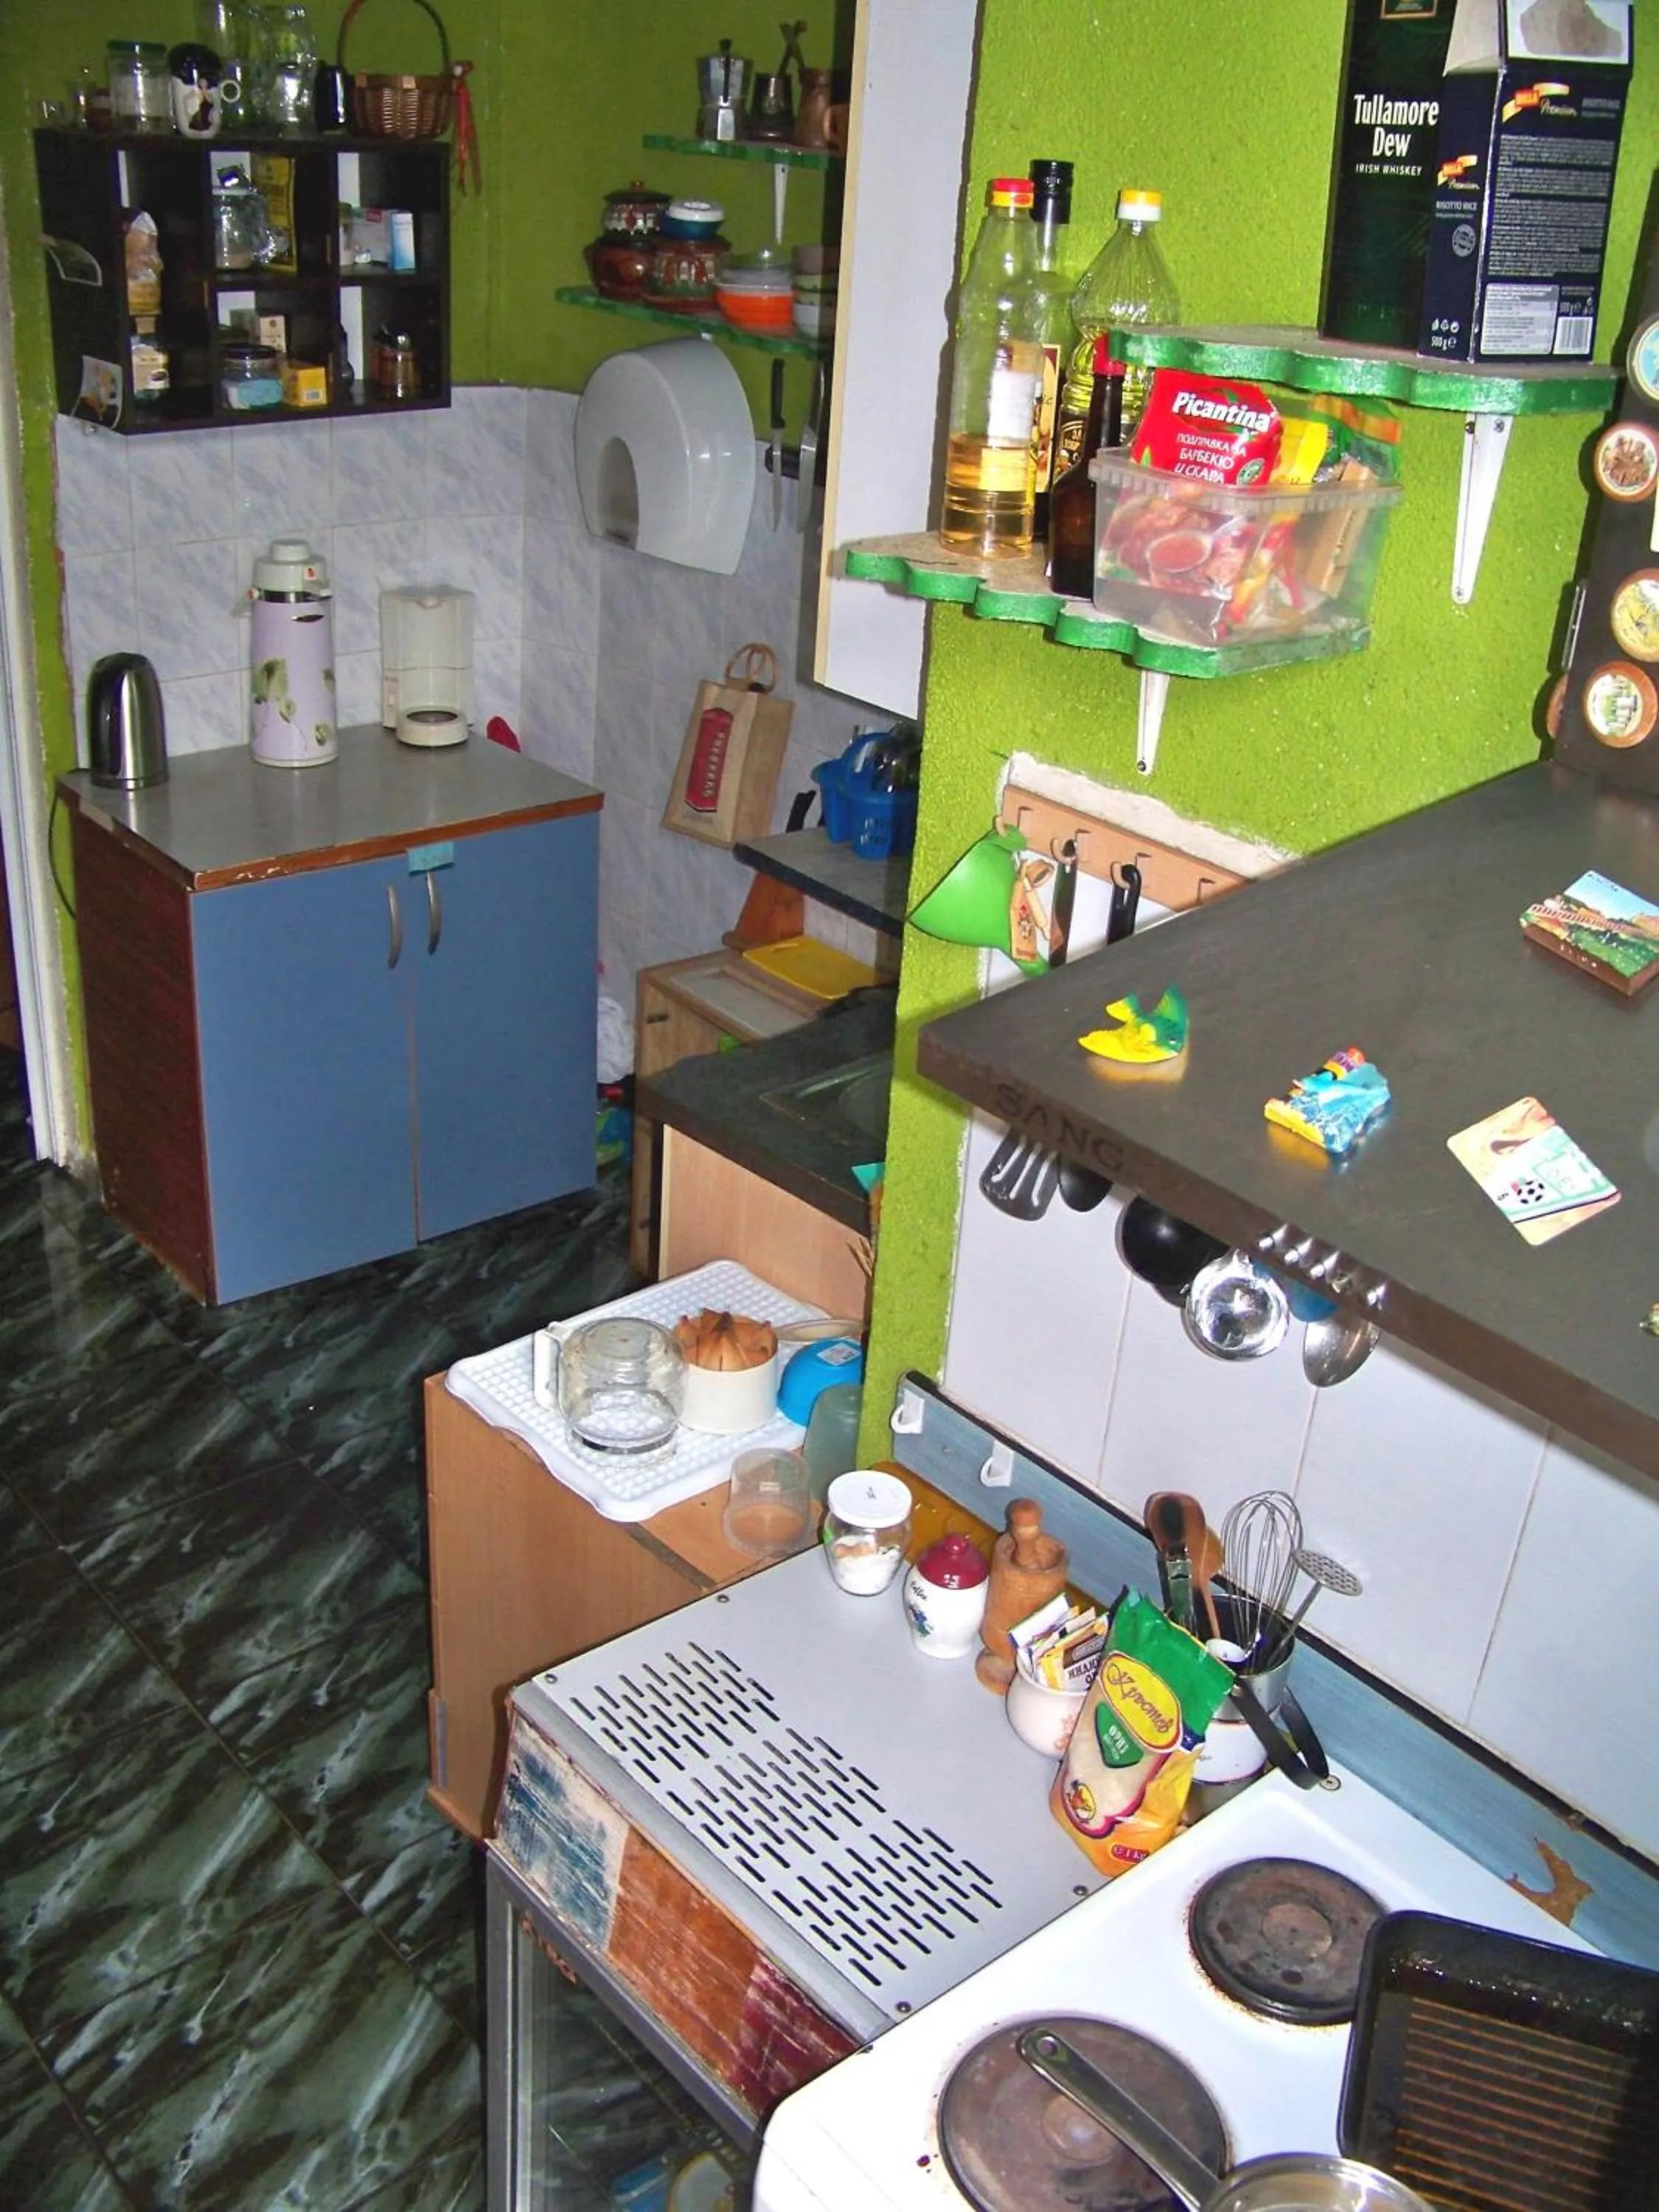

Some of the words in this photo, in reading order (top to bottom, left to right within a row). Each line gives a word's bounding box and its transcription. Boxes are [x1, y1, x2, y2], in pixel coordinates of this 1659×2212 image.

[1353, 94, 1440, 126] Tullamore
[1371, 127, 1412, 157] Dew
[1355, 162, 1380, 175] IRISH
[1382, 164, 1423, 177] WHISKEY
[1172, 391, 1271, 434] Picantina
[1185, 465, 1225, 484] СКАРА
